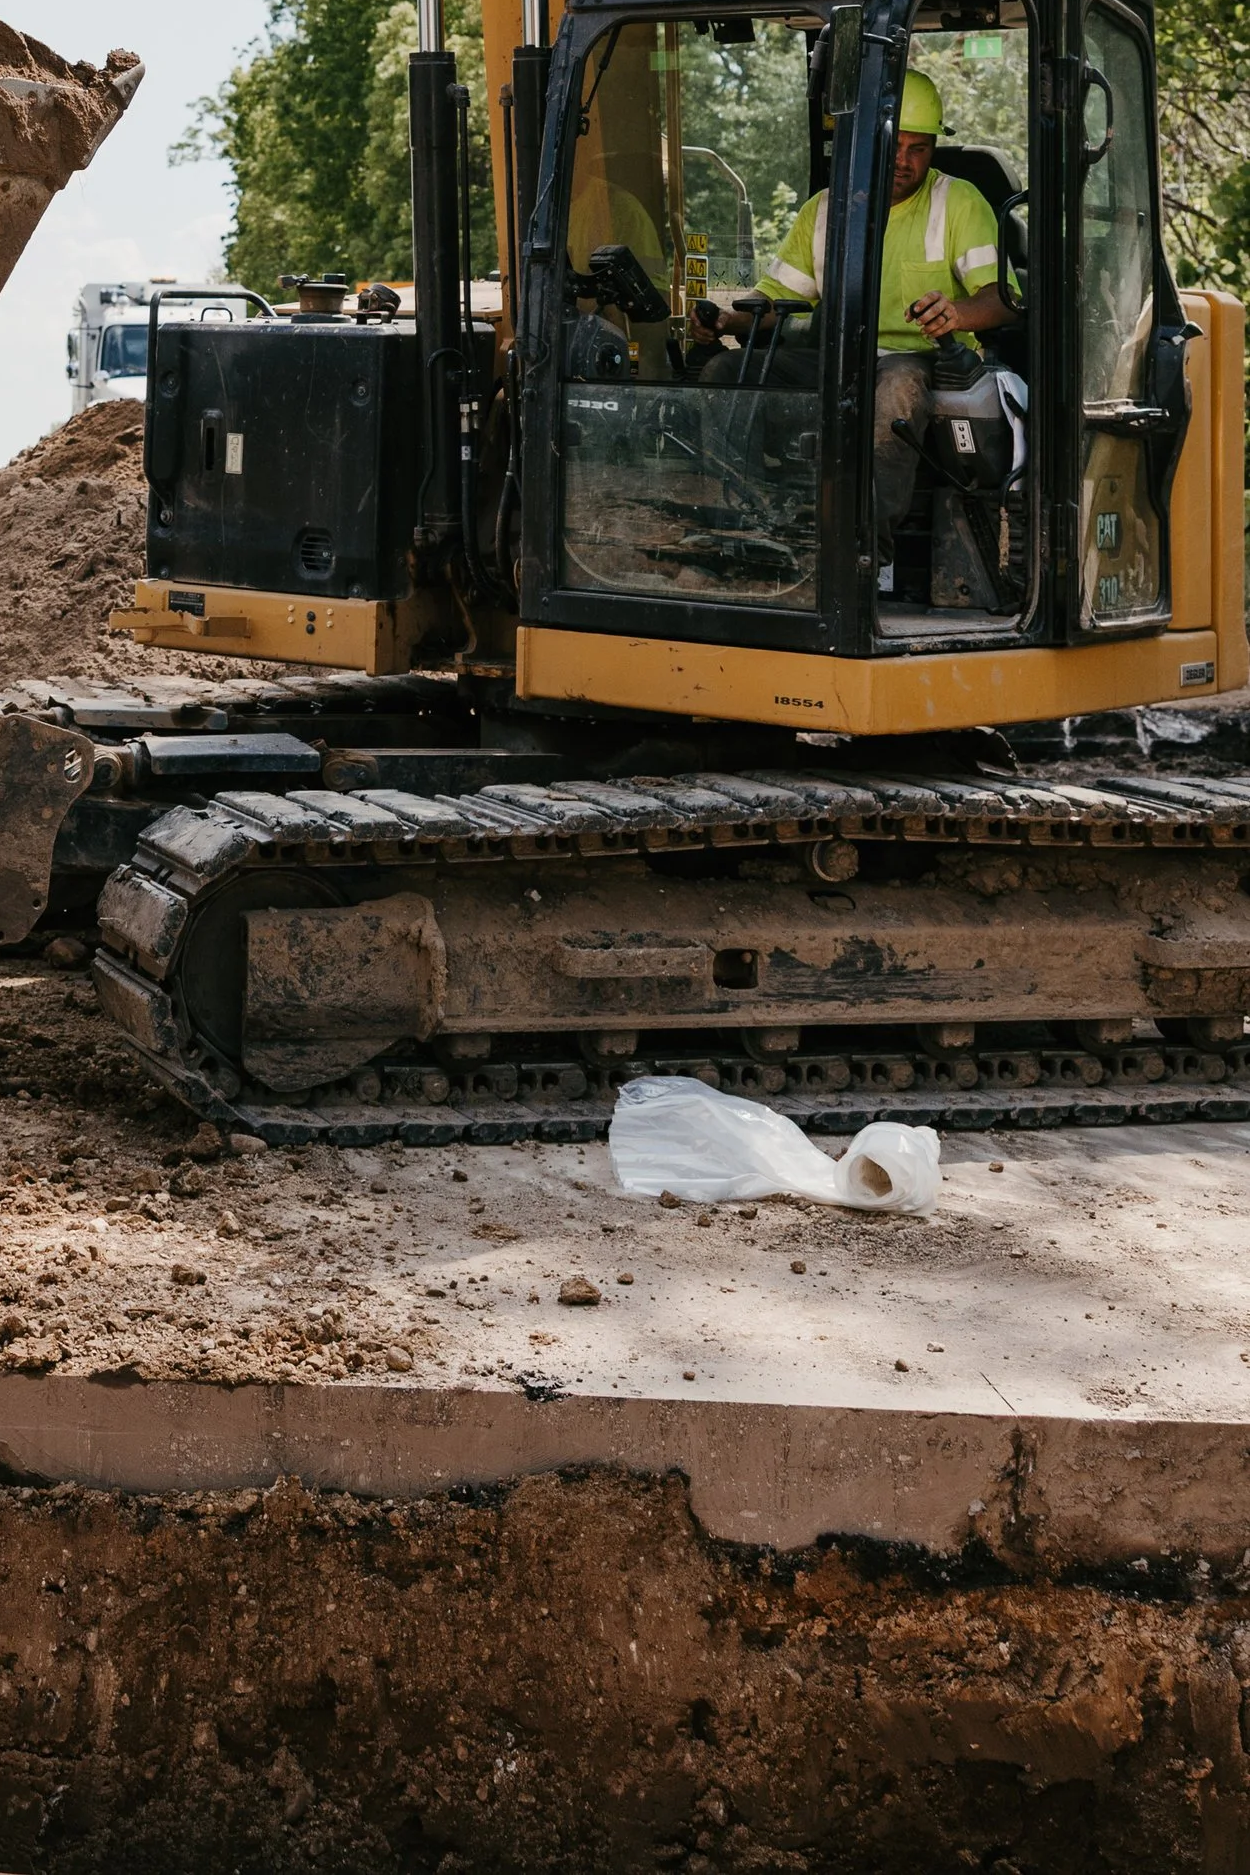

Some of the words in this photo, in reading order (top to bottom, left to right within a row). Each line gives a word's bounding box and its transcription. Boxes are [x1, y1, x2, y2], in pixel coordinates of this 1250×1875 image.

[1097, 513, 1118, 548] CAT
[1099, 576, 1119, 606] 310
[774, 696, 824, 709] 18554
